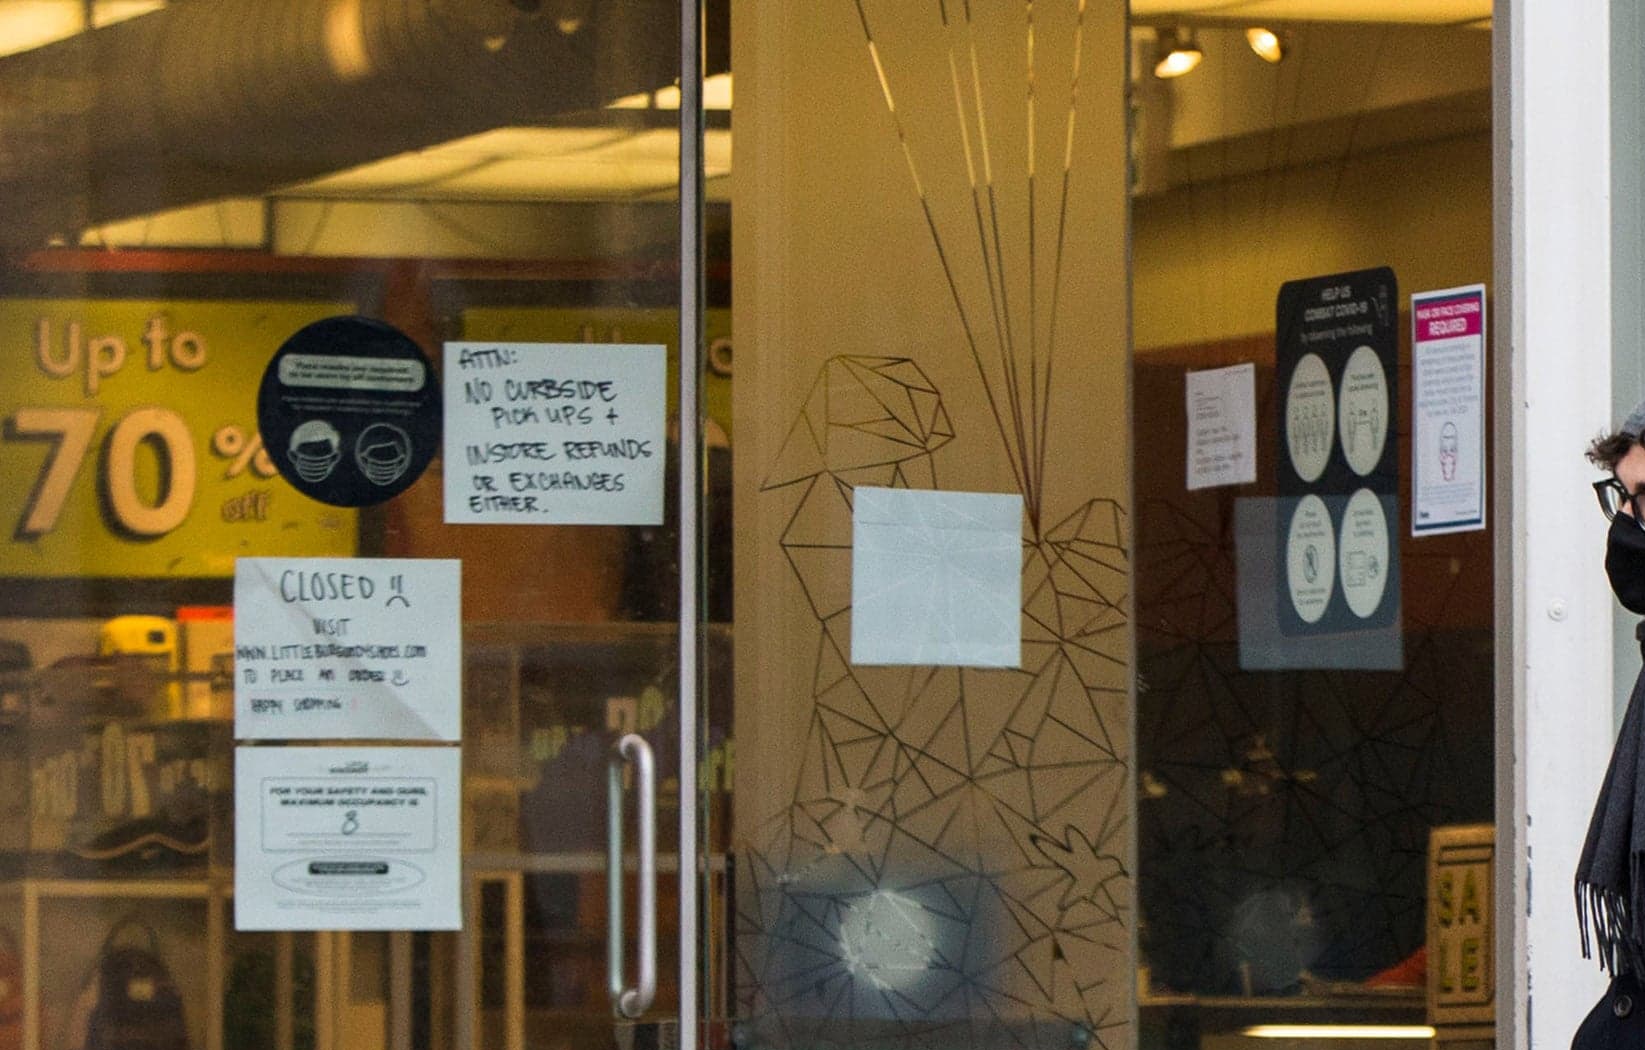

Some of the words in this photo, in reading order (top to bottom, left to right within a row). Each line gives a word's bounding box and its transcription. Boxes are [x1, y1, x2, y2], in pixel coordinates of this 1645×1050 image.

[1428, 317, 1467, 336] REQUIRED
[37, 316, 126, 396] Up
[143, 312, 207, 371] to
[459, 349, 518, 369] ATTN:
[465, 378, 492, 404] NO
[505, 379, 618, 401] CURBSIDE
[491, 407, 539, 428] PICK
[546, 406, 593, 425] UPS
[466, 442, 556, 465] INSTORE
[563, 439, 653, 460] REFUNDS
[473, 476, 498, 491] OR
[510, 471, 625, 492] EXCHANGES
[221, 489, 271, 522] off
[469, 495, 548, 513] EITHER.
[281, 569, 375, 603] CLOSED
[313, 618, 351, 636] VISIT
[243, 668, 257, 684] TO
[271, 669, 304, 682] PLACE
[341, 810, 360, 836] 8
